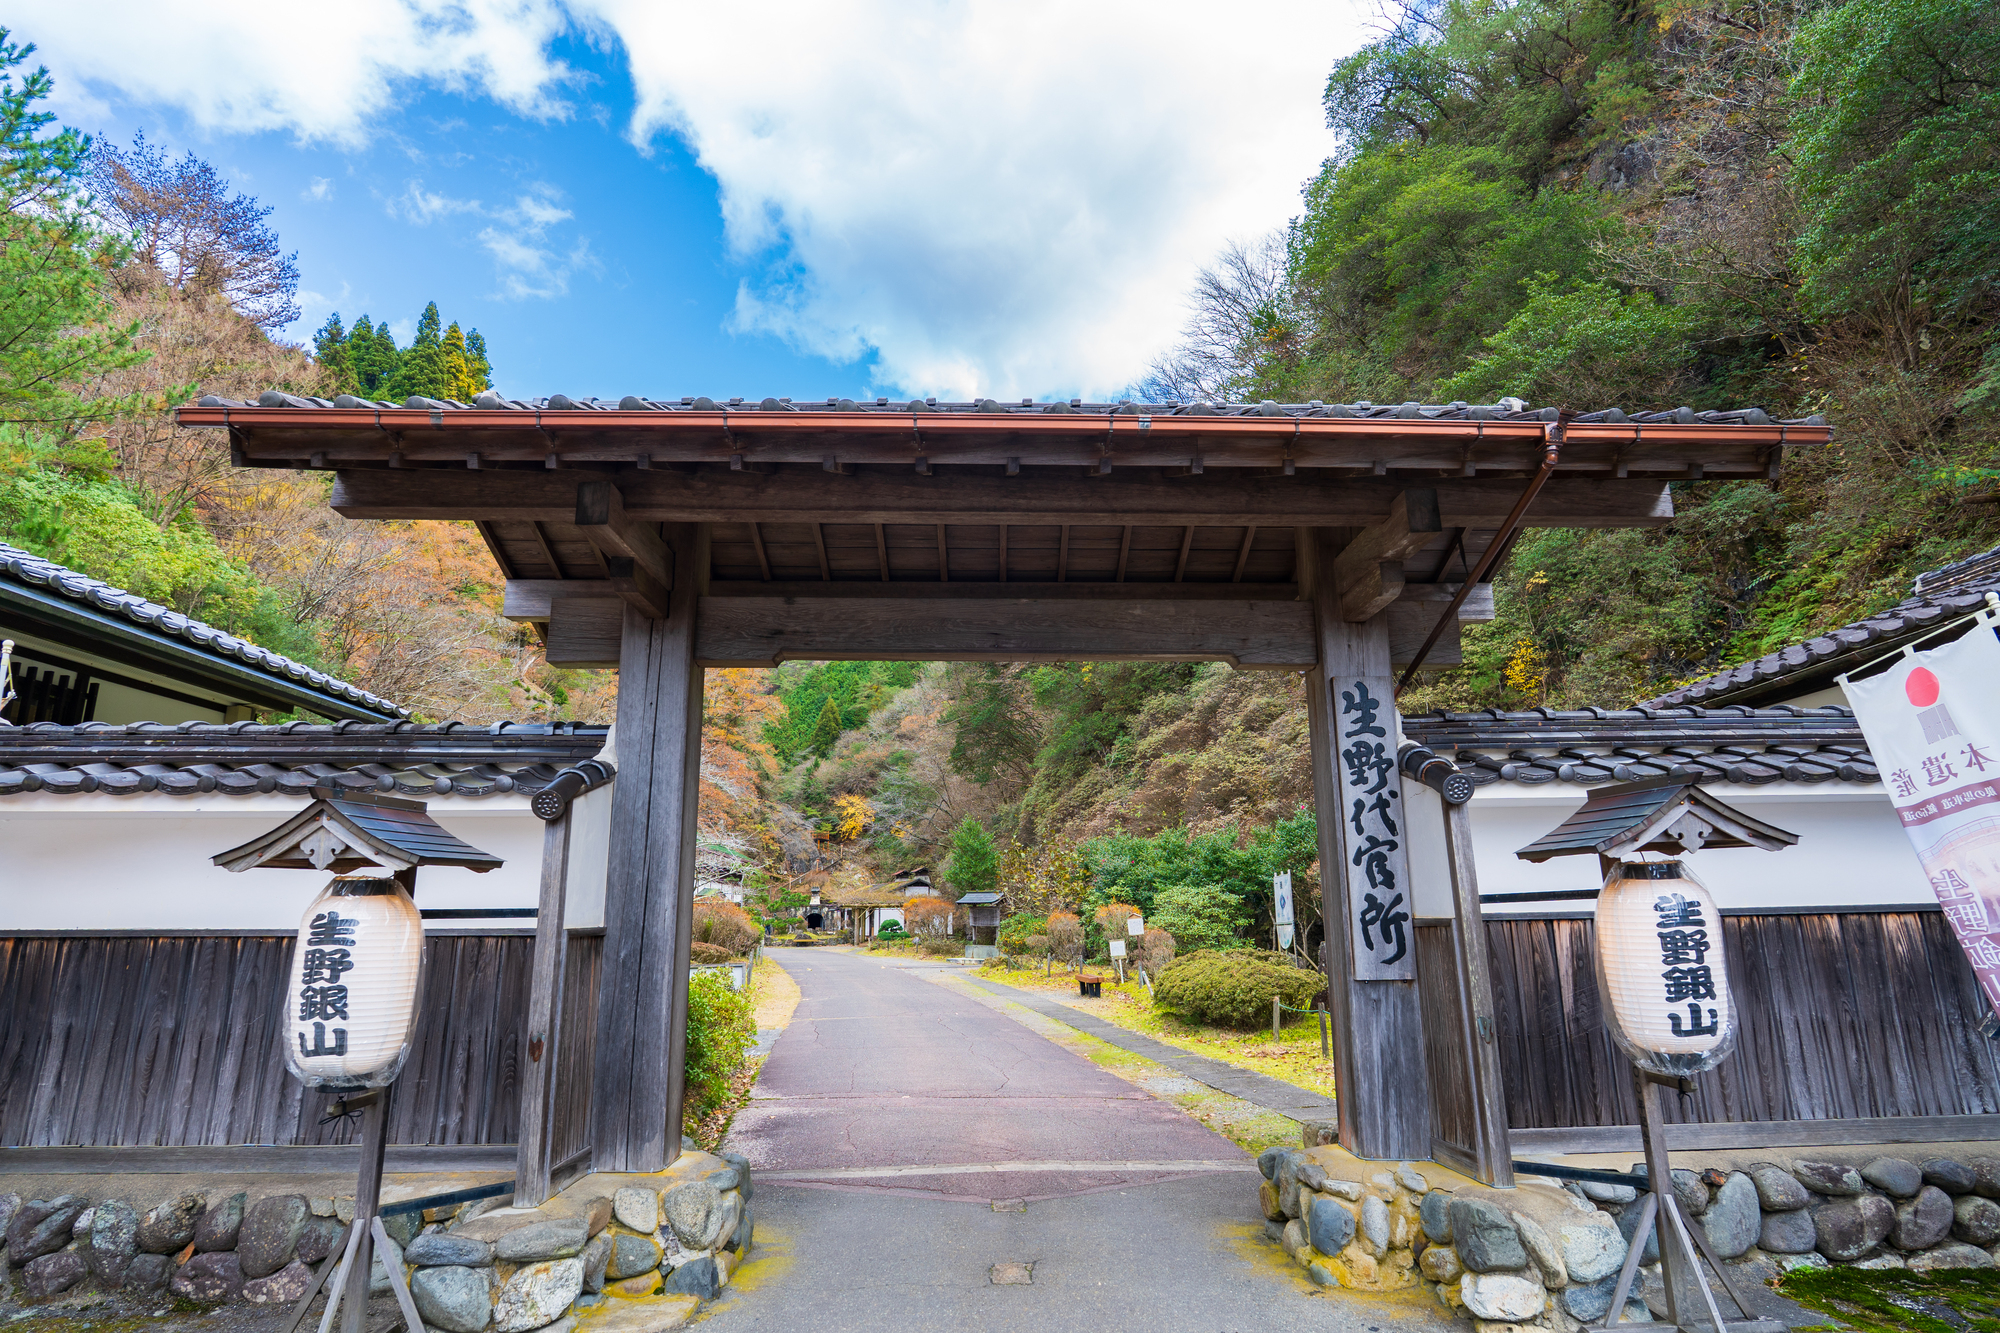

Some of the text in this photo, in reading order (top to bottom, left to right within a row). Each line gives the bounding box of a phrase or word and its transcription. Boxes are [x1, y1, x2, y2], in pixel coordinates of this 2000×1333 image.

[1341, 681, 1409, 965] 生野代官所
[298, 910, 360, 1058] 生野銀山
[1653, 892, 1719, 1038] 生野銀山
